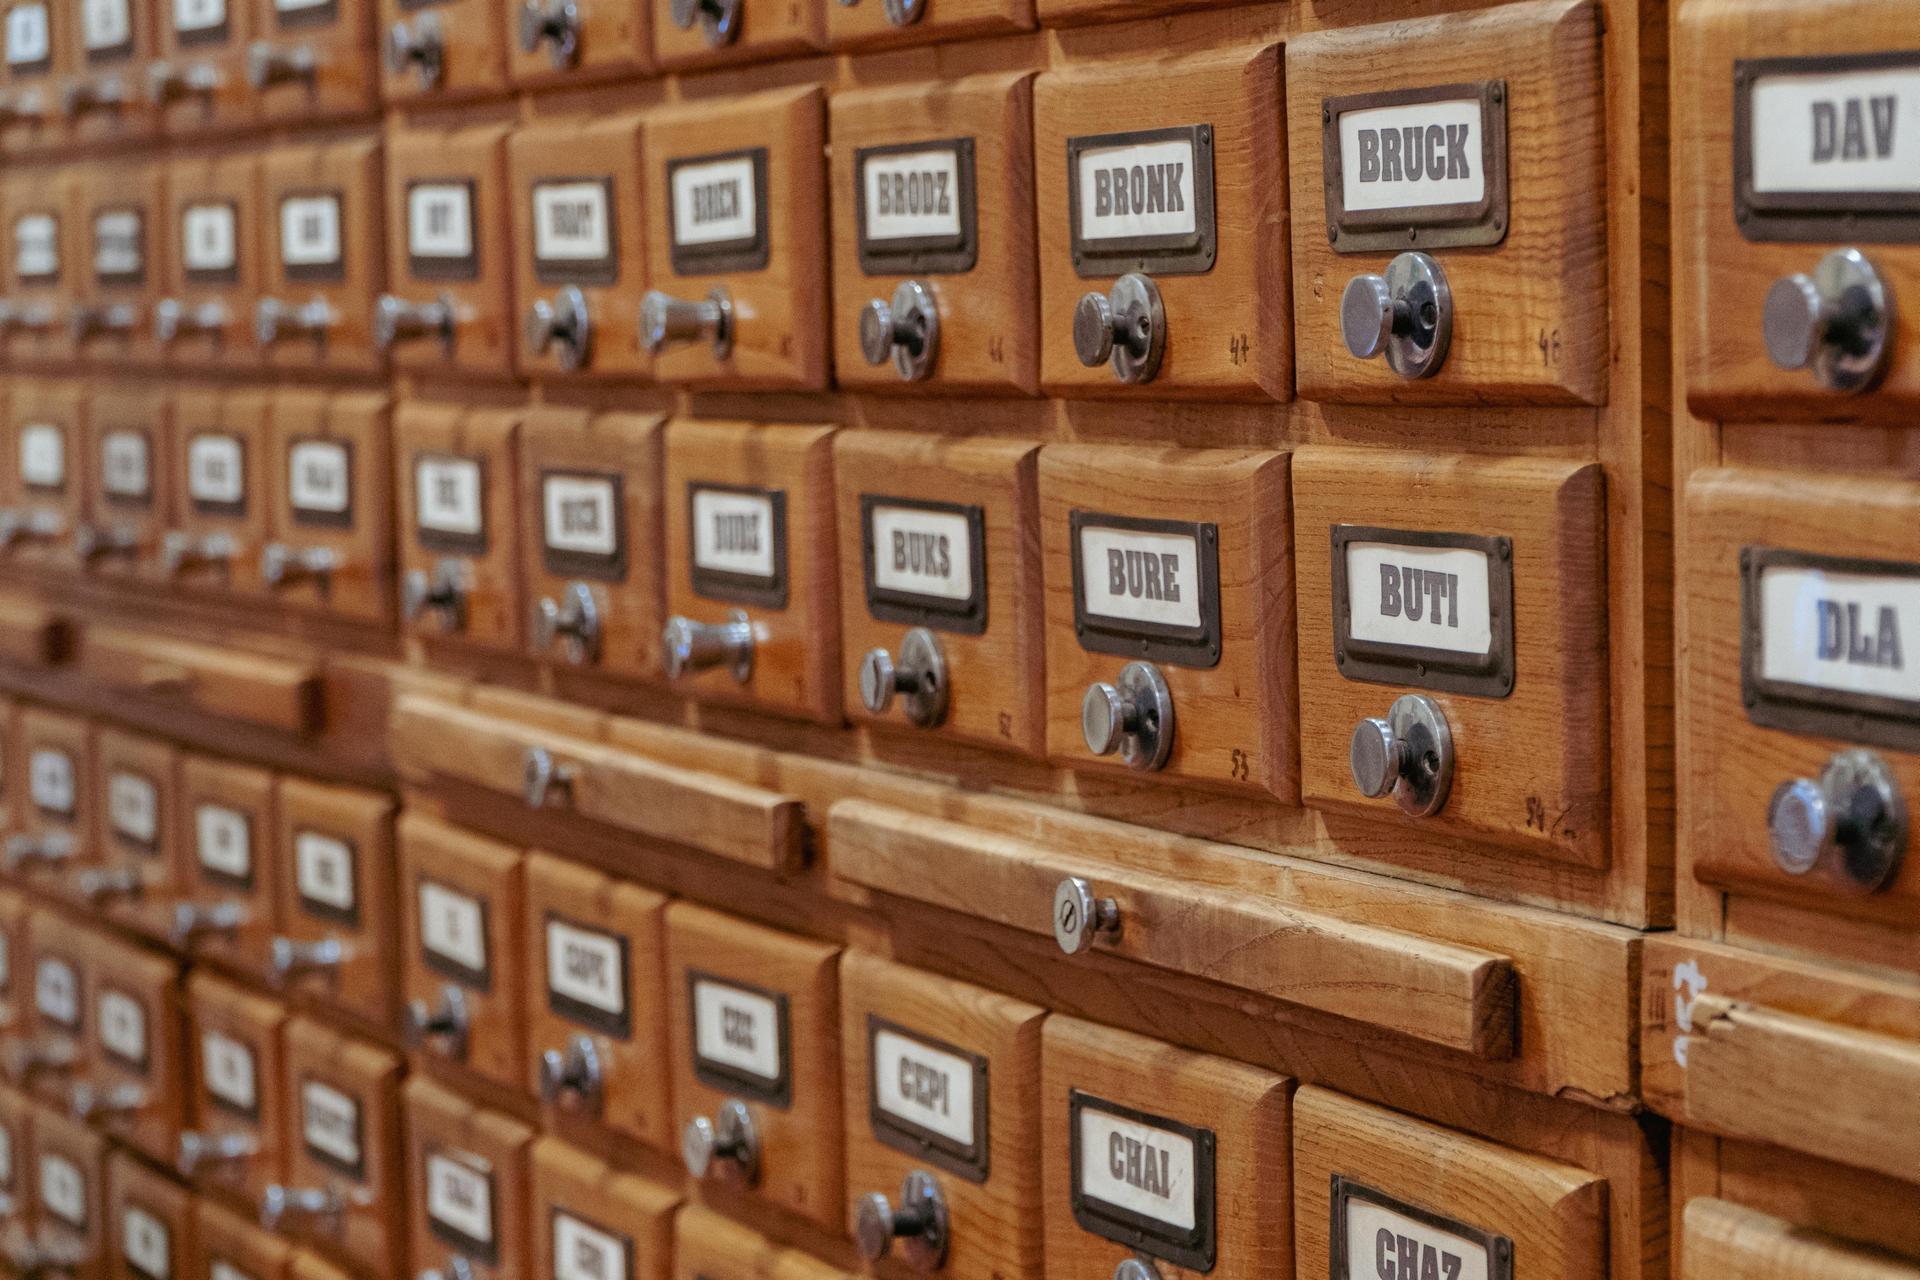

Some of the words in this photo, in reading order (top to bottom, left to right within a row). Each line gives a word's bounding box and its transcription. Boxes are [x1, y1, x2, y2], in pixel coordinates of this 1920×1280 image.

[1358, 124, 1470, 182] BRUCK
[1810, 94, 1898, 164] DAV
[877, 170, 951, 216] BRODZ
[1094, 162, 1185, 217] BRONK
[892, 530, 951, 580] BUKS
[1107, 548, 1181, 603] BURE
[1379, 563, 1459, 628] BUTI
[1816, 599, 1904, 670] DLA
[899, 1056, 950, 1116] CEPI
[1108, 1130, 1171, 1199] CHAI
[1376, 1227, 1463, 1280] CHAZ
